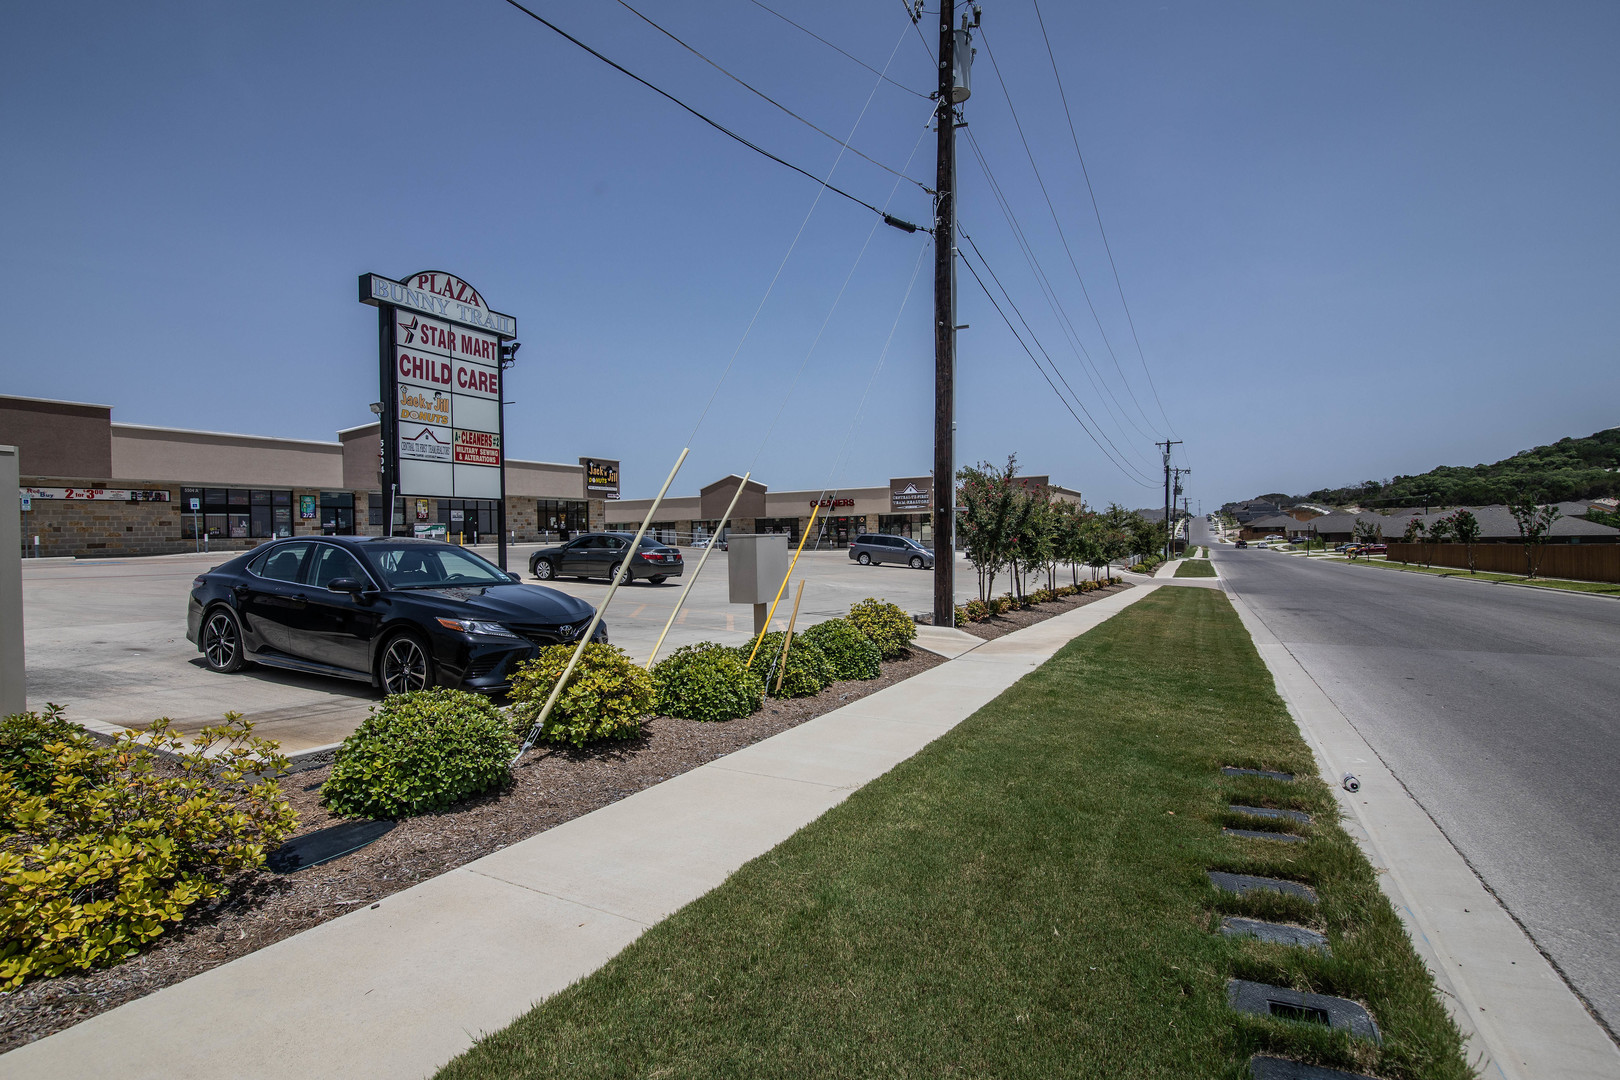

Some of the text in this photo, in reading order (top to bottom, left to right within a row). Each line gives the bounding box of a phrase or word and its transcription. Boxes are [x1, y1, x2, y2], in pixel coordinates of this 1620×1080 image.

[416, 273, 481, 308] PLAZA
[373, 277, 515, 335] BUNNY TRAIL
[420, 323, 497, 361] STAR MART
[399, 353, 498, 394] CHILD CARE
[400, 392, 426, 410] Jack
[433, 398, 450, 413] Jill
[401, 409, 449, 424] DONUTS
[461, 431, 493, 447] CLEANERS
[456, 446, 499, 457] MILITARY SEWING
[464, 454, 497, 463] ALTERATIONS
[589, 466, 603, 476] Jack
[608, 472, 618, 482] Jill
[65, 488, 74, 499] 2
[810, 499, 855, 508] CLEANERS
